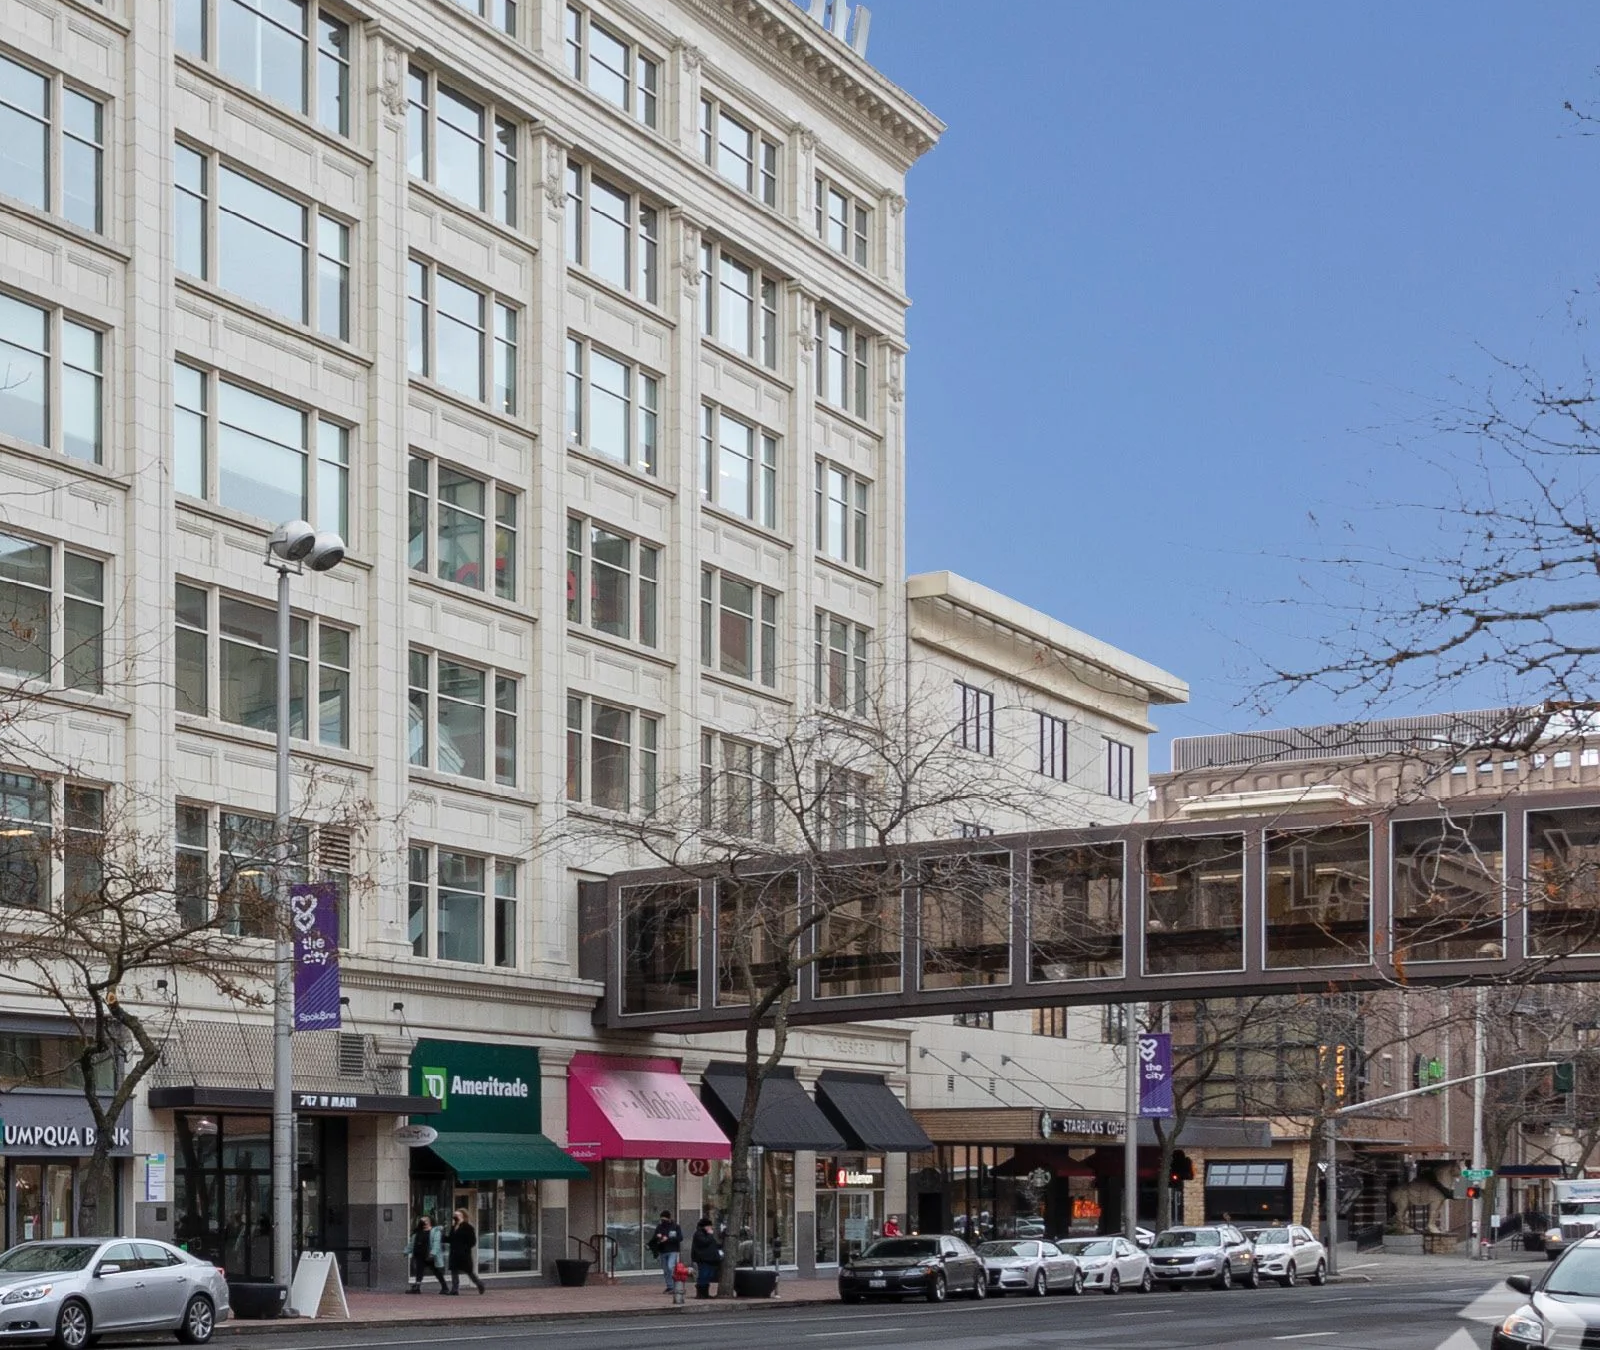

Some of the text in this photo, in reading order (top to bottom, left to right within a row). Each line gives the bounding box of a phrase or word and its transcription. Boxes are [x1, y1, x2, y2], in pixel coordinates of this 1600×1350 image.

[302, 937, 325, 950] the
[303, 950, 329, 965] city
[1145, 1063, 1162, 1071] the
[1145, 1072, 1166, 1080] city
[451, 1076, 529, 1097] Ameritrade
[320, 1095, 329, 1107] W
[331, 1096, 357, 1108] MAIN
[1063, 1119, 1103, 1134] STARBUCKS
[5, 1125, 130, 1147] UMPQUA BNK
